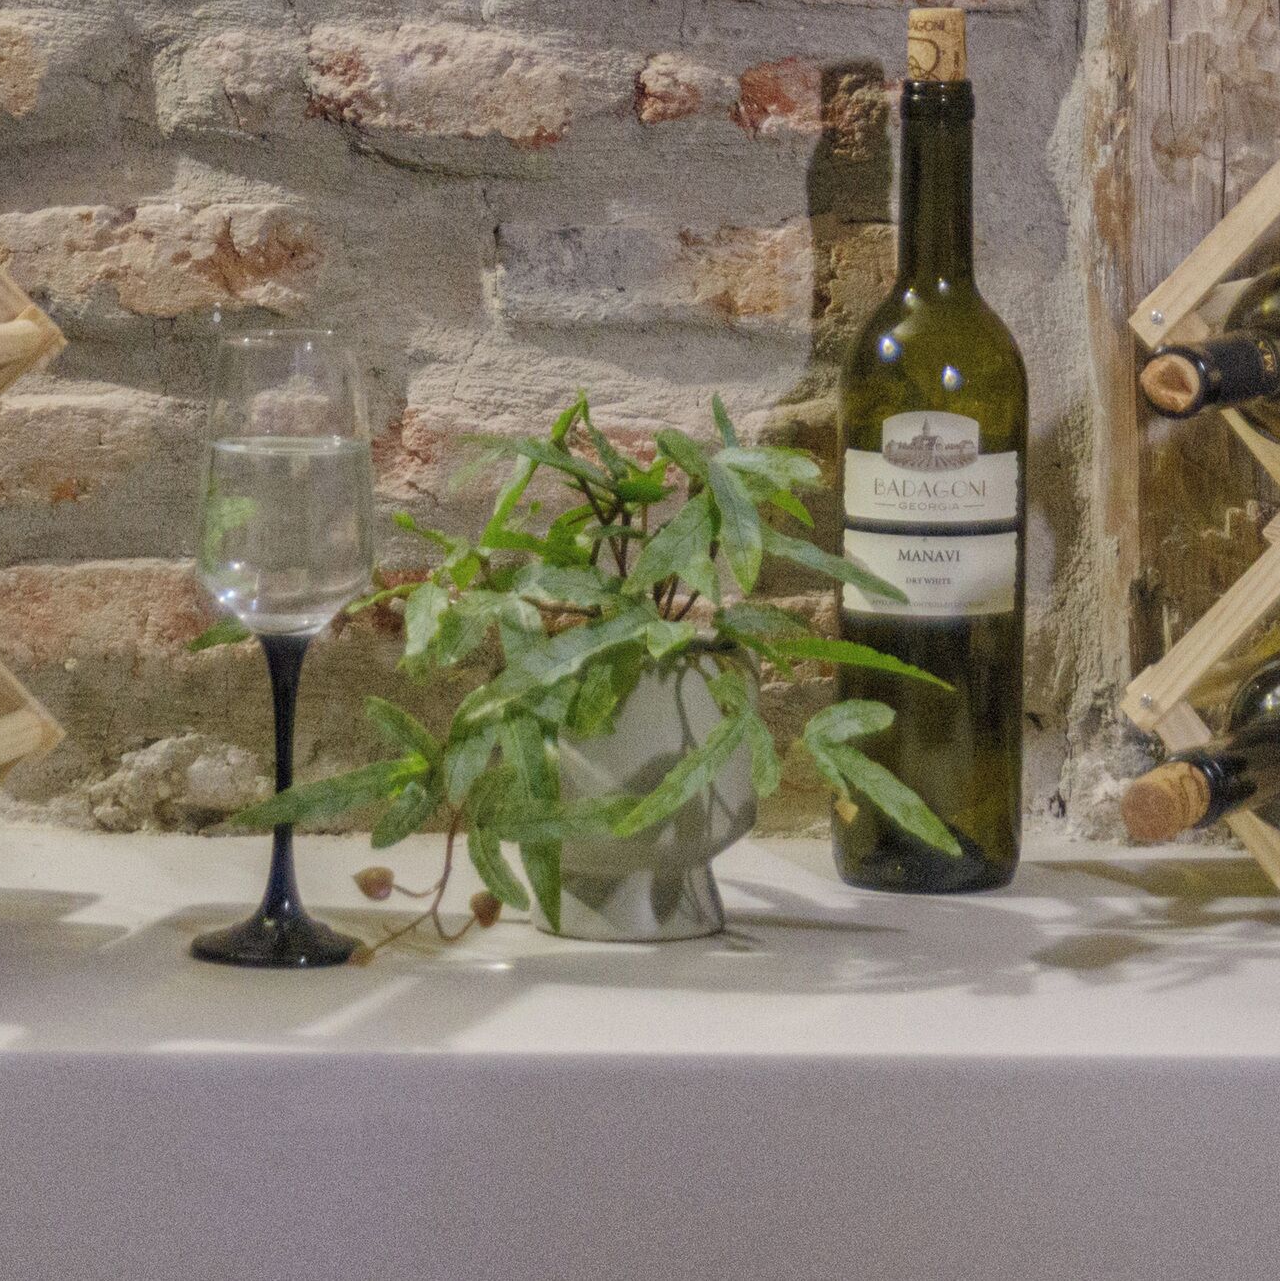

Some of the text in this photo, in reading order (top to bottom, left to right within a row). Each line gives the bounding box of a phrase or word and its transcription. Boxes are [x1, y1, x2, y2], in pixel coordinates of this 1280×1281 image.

[874, 478, 986, 498] BADAGONI
[898, 501, 960, 512] GEORGIA
[897, 549, 961, 563] MANAVI
[923, 577, 951, 585] WHITE
